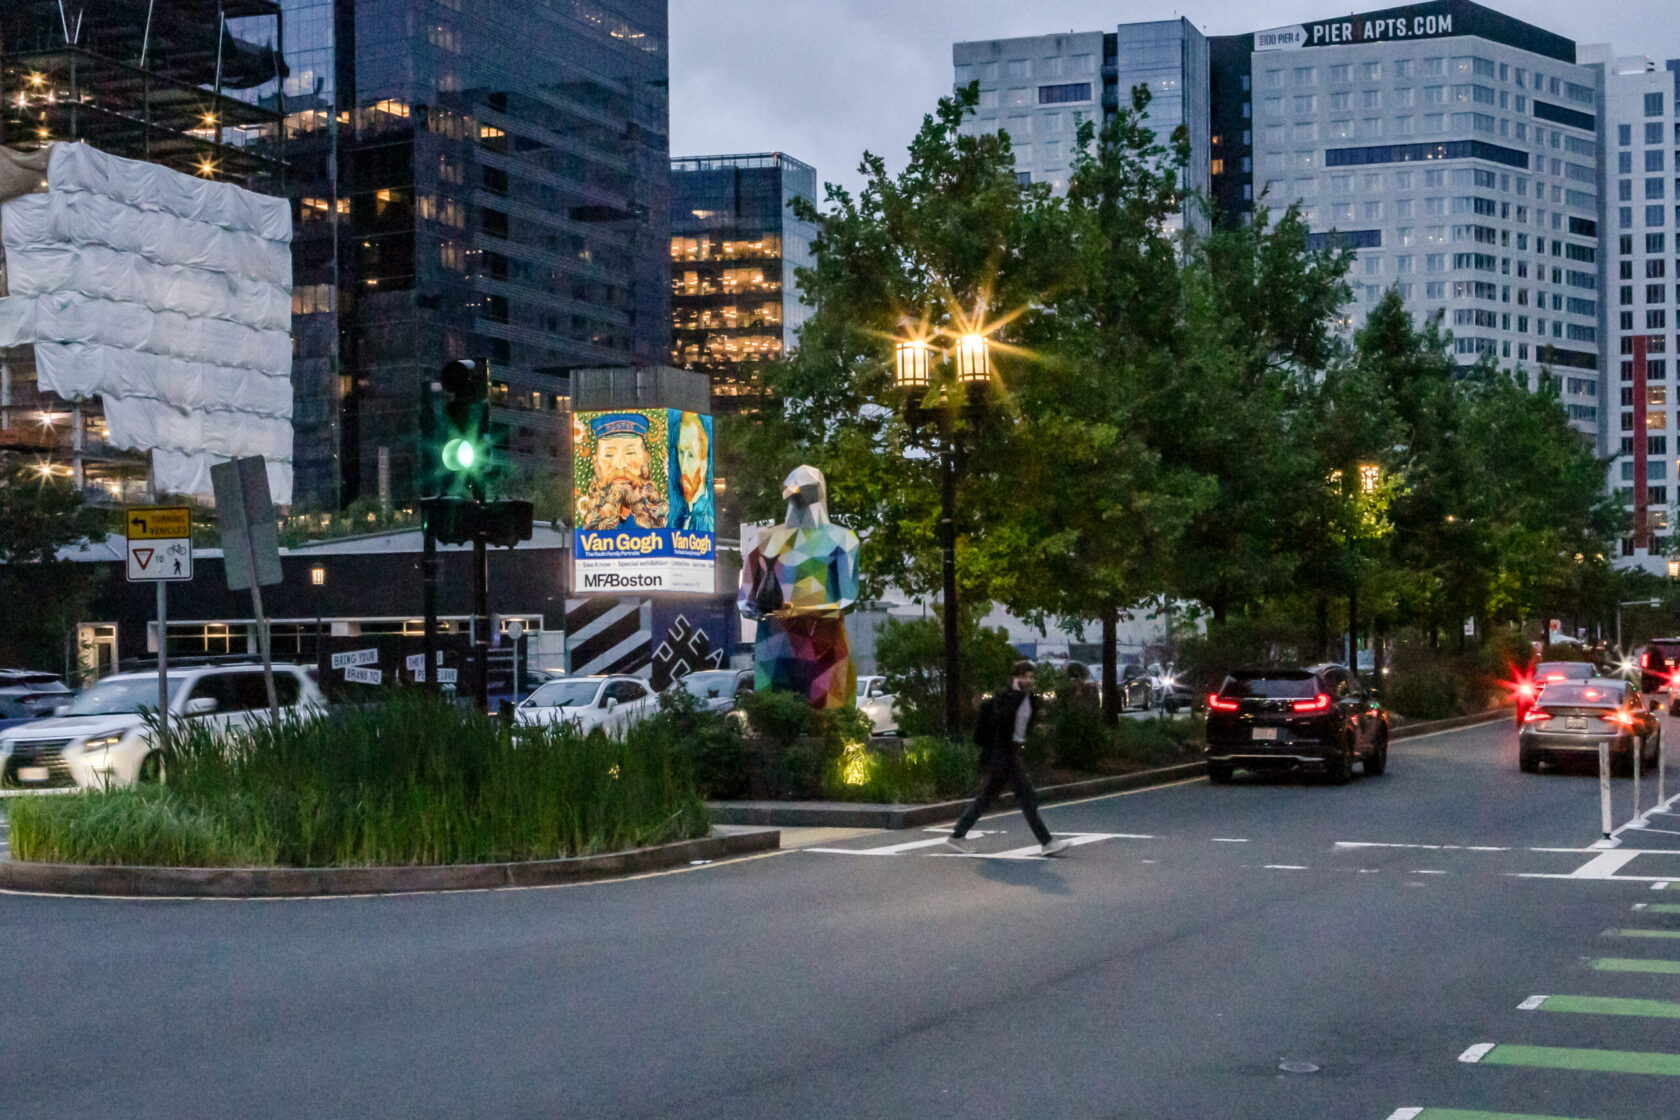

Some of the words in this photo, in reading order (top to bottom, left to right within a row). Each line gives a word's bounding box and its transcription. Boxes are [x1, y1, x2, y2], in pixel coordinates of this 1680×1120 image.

[1313, 22, 1352, 43] PIER
[1363, 14, 1453, 39] APTS.COM
[1264, 34, 1276, 45] 100
[1278, 33, 1293, 44] PIER
[150, 526, 187, 535] VEHICLES
[580, 533, 614, 551] Van
[616, 532, 663, 554] Gogh
[671, 531, 689, 549] Van
[689, 533, 712, 555] Gogh
[333, 653, 357, 666] BRING
[357, 651, 375, 663] YOUR
[346, 667, 368, 681] BRAND
